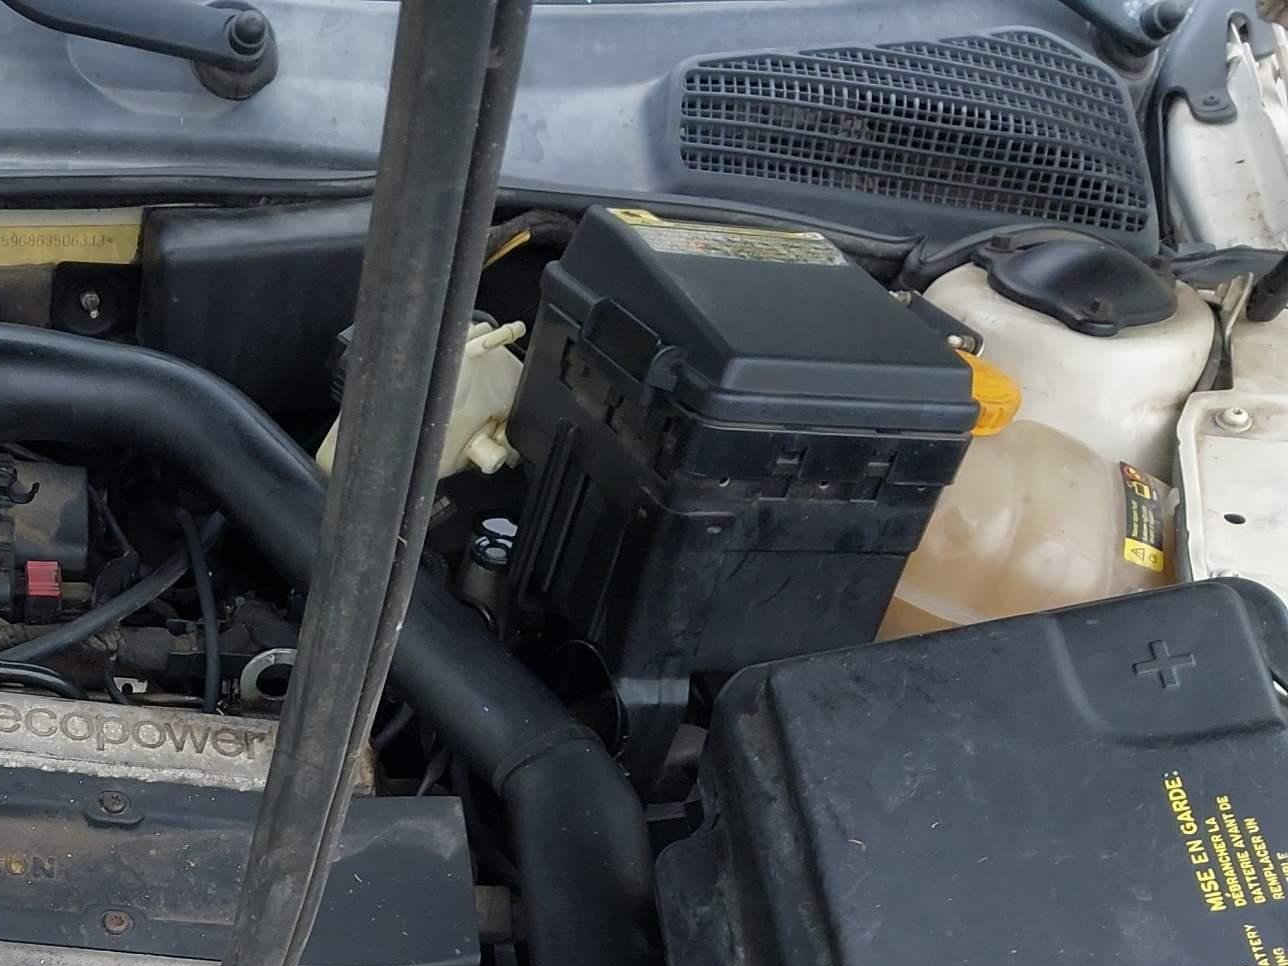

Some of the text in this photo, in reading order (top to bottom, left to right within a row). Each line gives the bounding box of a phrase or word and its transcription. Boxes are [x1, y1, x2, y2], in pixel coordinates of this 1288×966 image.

[1163, 770, 1227, 912] MISE EN GARDE:
[1205, 817, 1247, 908] DÉBRANCHER LA
[1216, 795, 1266, 904] BATTERIE AVANT DE
[1243, 817, 1259, 833] UN
[1251, 835, 1286, 900] REMPLACER
